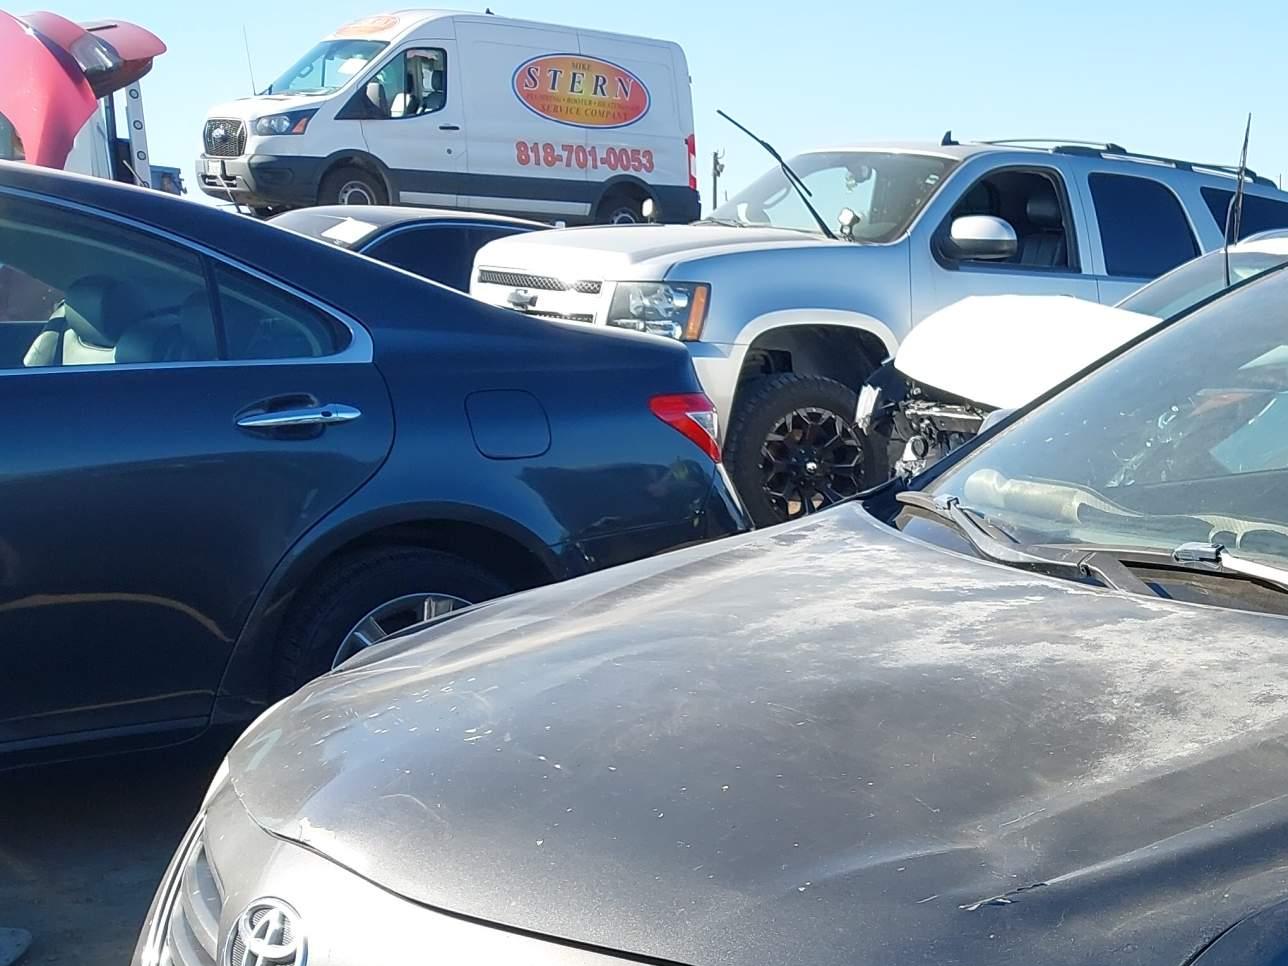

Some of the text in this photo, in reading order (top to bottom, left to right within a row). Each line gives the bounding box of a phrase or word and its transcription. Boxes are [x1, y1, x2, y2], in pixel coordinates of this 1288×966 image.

[571, 62, 591, 71] MIKE
[523, 66, 634, 101] STERN
[541, 104, 580, 115] SERVICE
[584, 107, 628, 121] COMPANY
[515, 140, 655, 173] 818-701-0053
